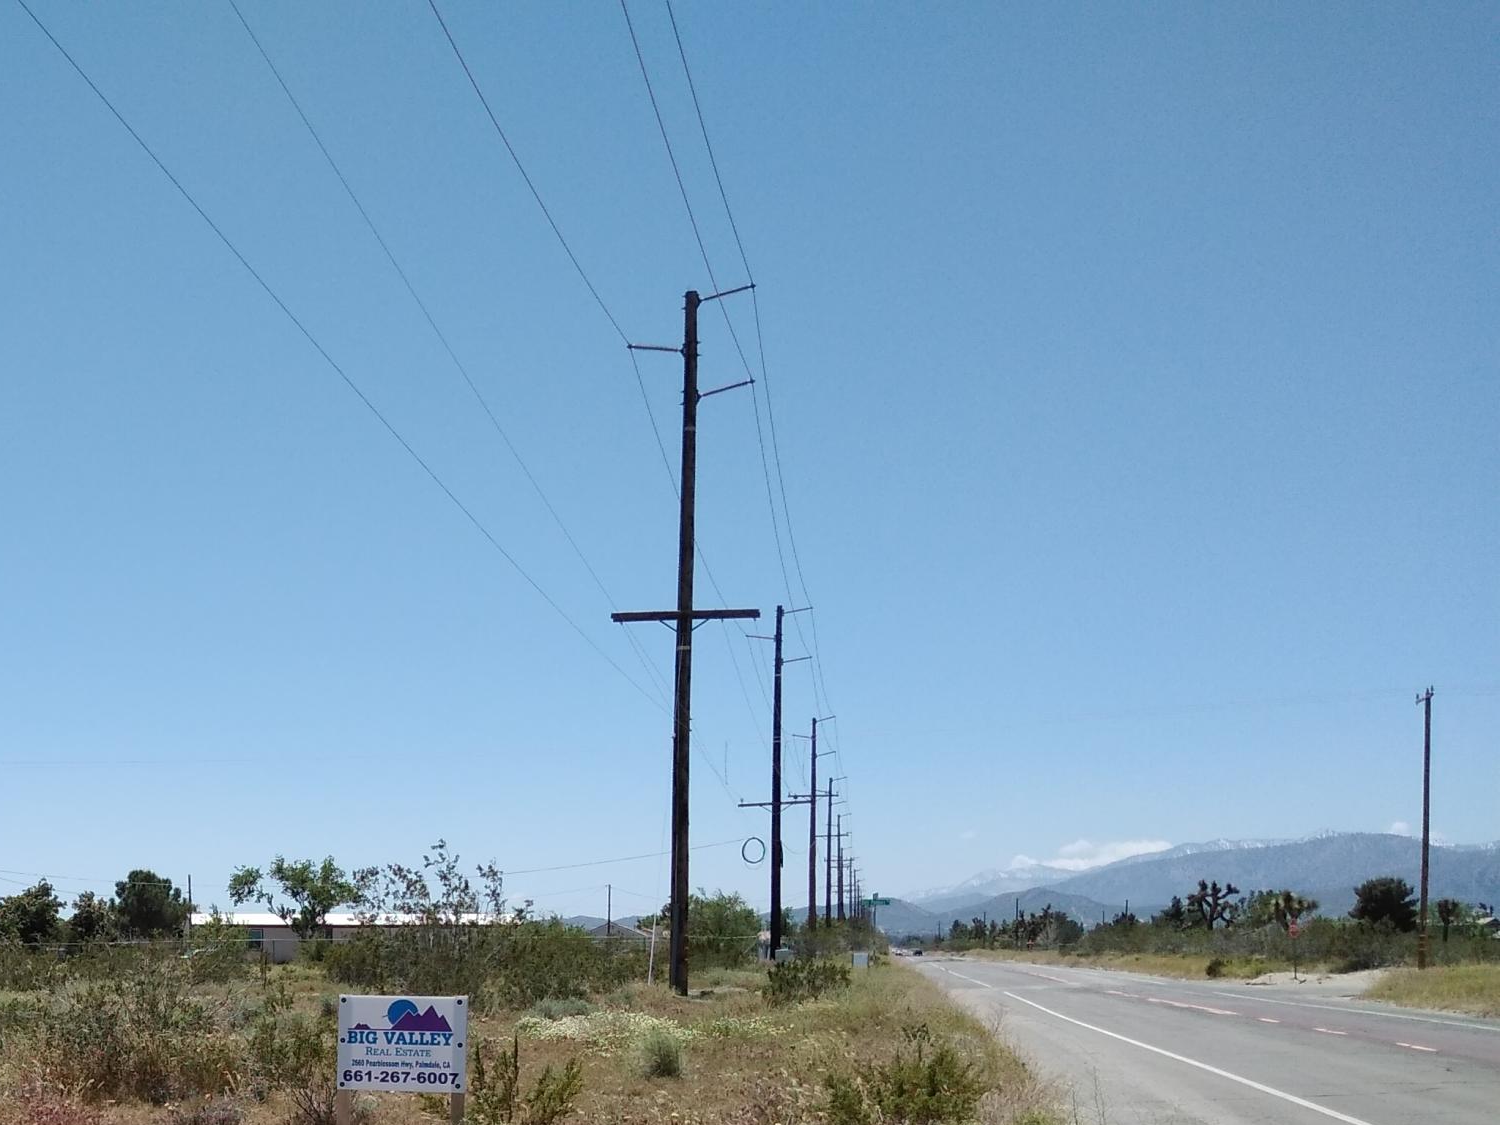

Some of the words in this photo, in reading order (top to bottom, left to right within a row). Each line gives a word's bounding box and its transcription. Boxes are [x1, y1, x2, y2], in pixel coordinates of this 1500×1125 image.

[347, 1031, 378, 1044] BIG
[383, 1031, 454, 1046] VALLEY
[366, 1047, 392, 1056] REAL
[395, 1047, 432, 1057] ESTATE
[366, 1059, 399, 1068] Pearblossom
[442, 1061, 451, 1069] CA
[343, 1069, 459, 1085] 661-267-6007
